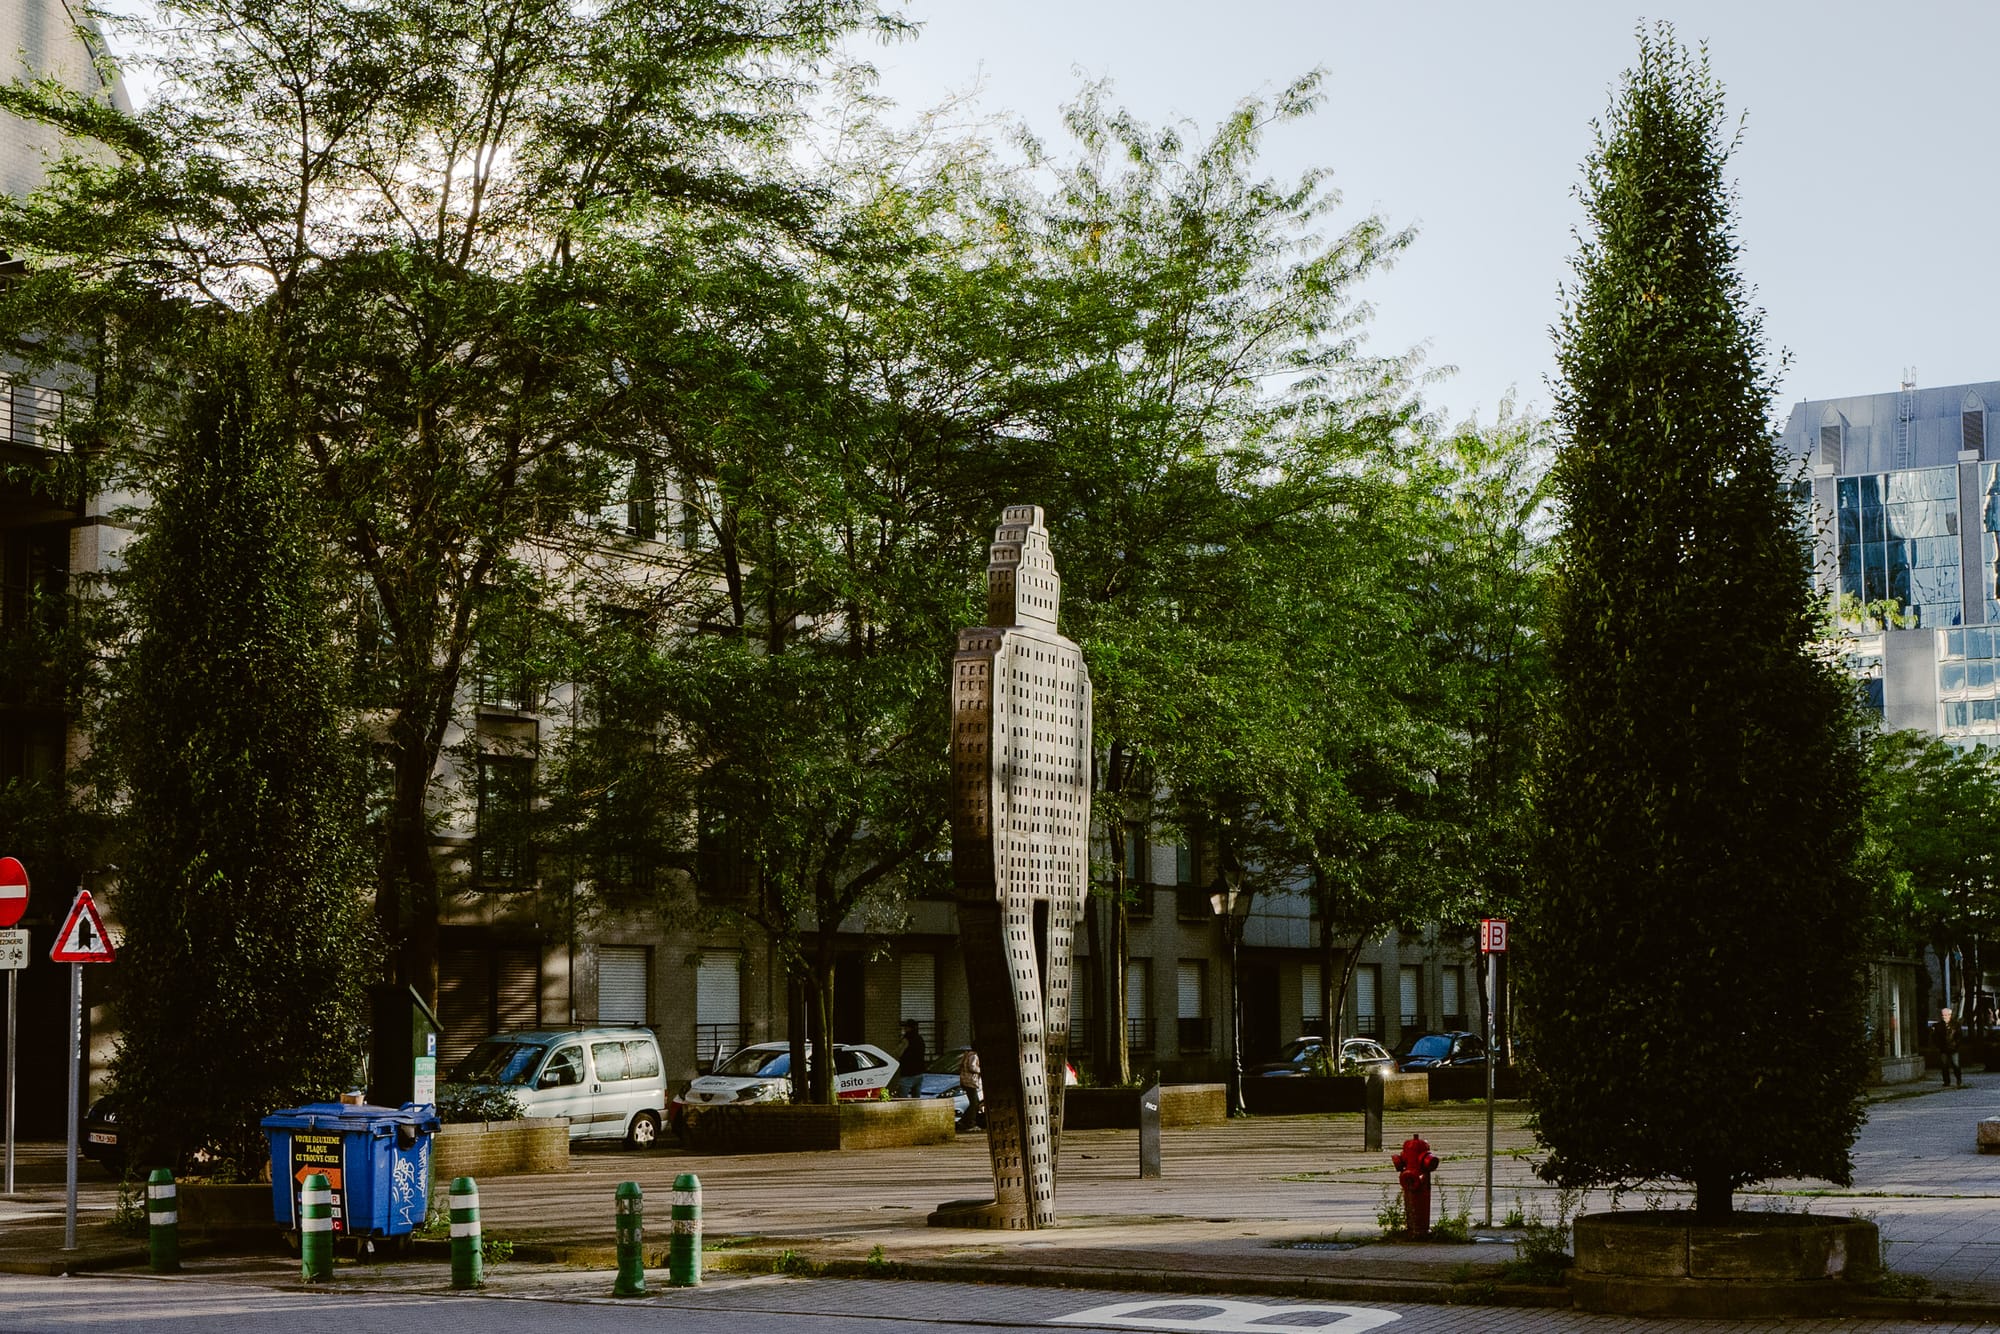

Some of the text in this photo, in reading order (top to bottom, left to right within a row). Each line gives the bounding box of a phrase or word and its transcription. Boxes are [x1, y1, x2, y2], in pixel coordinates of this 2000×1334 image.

[1492, 926, 1503, 946] B
[427, 1033, 437, 1052] P
[841, 1077, 864, 1088] asito
[295, 1135, 312, 1143] VOTRE
[306, 1145, 328, 1154] PLAQUE
[296, 1154, 339, 1164] CE TROUVE CHEZ
